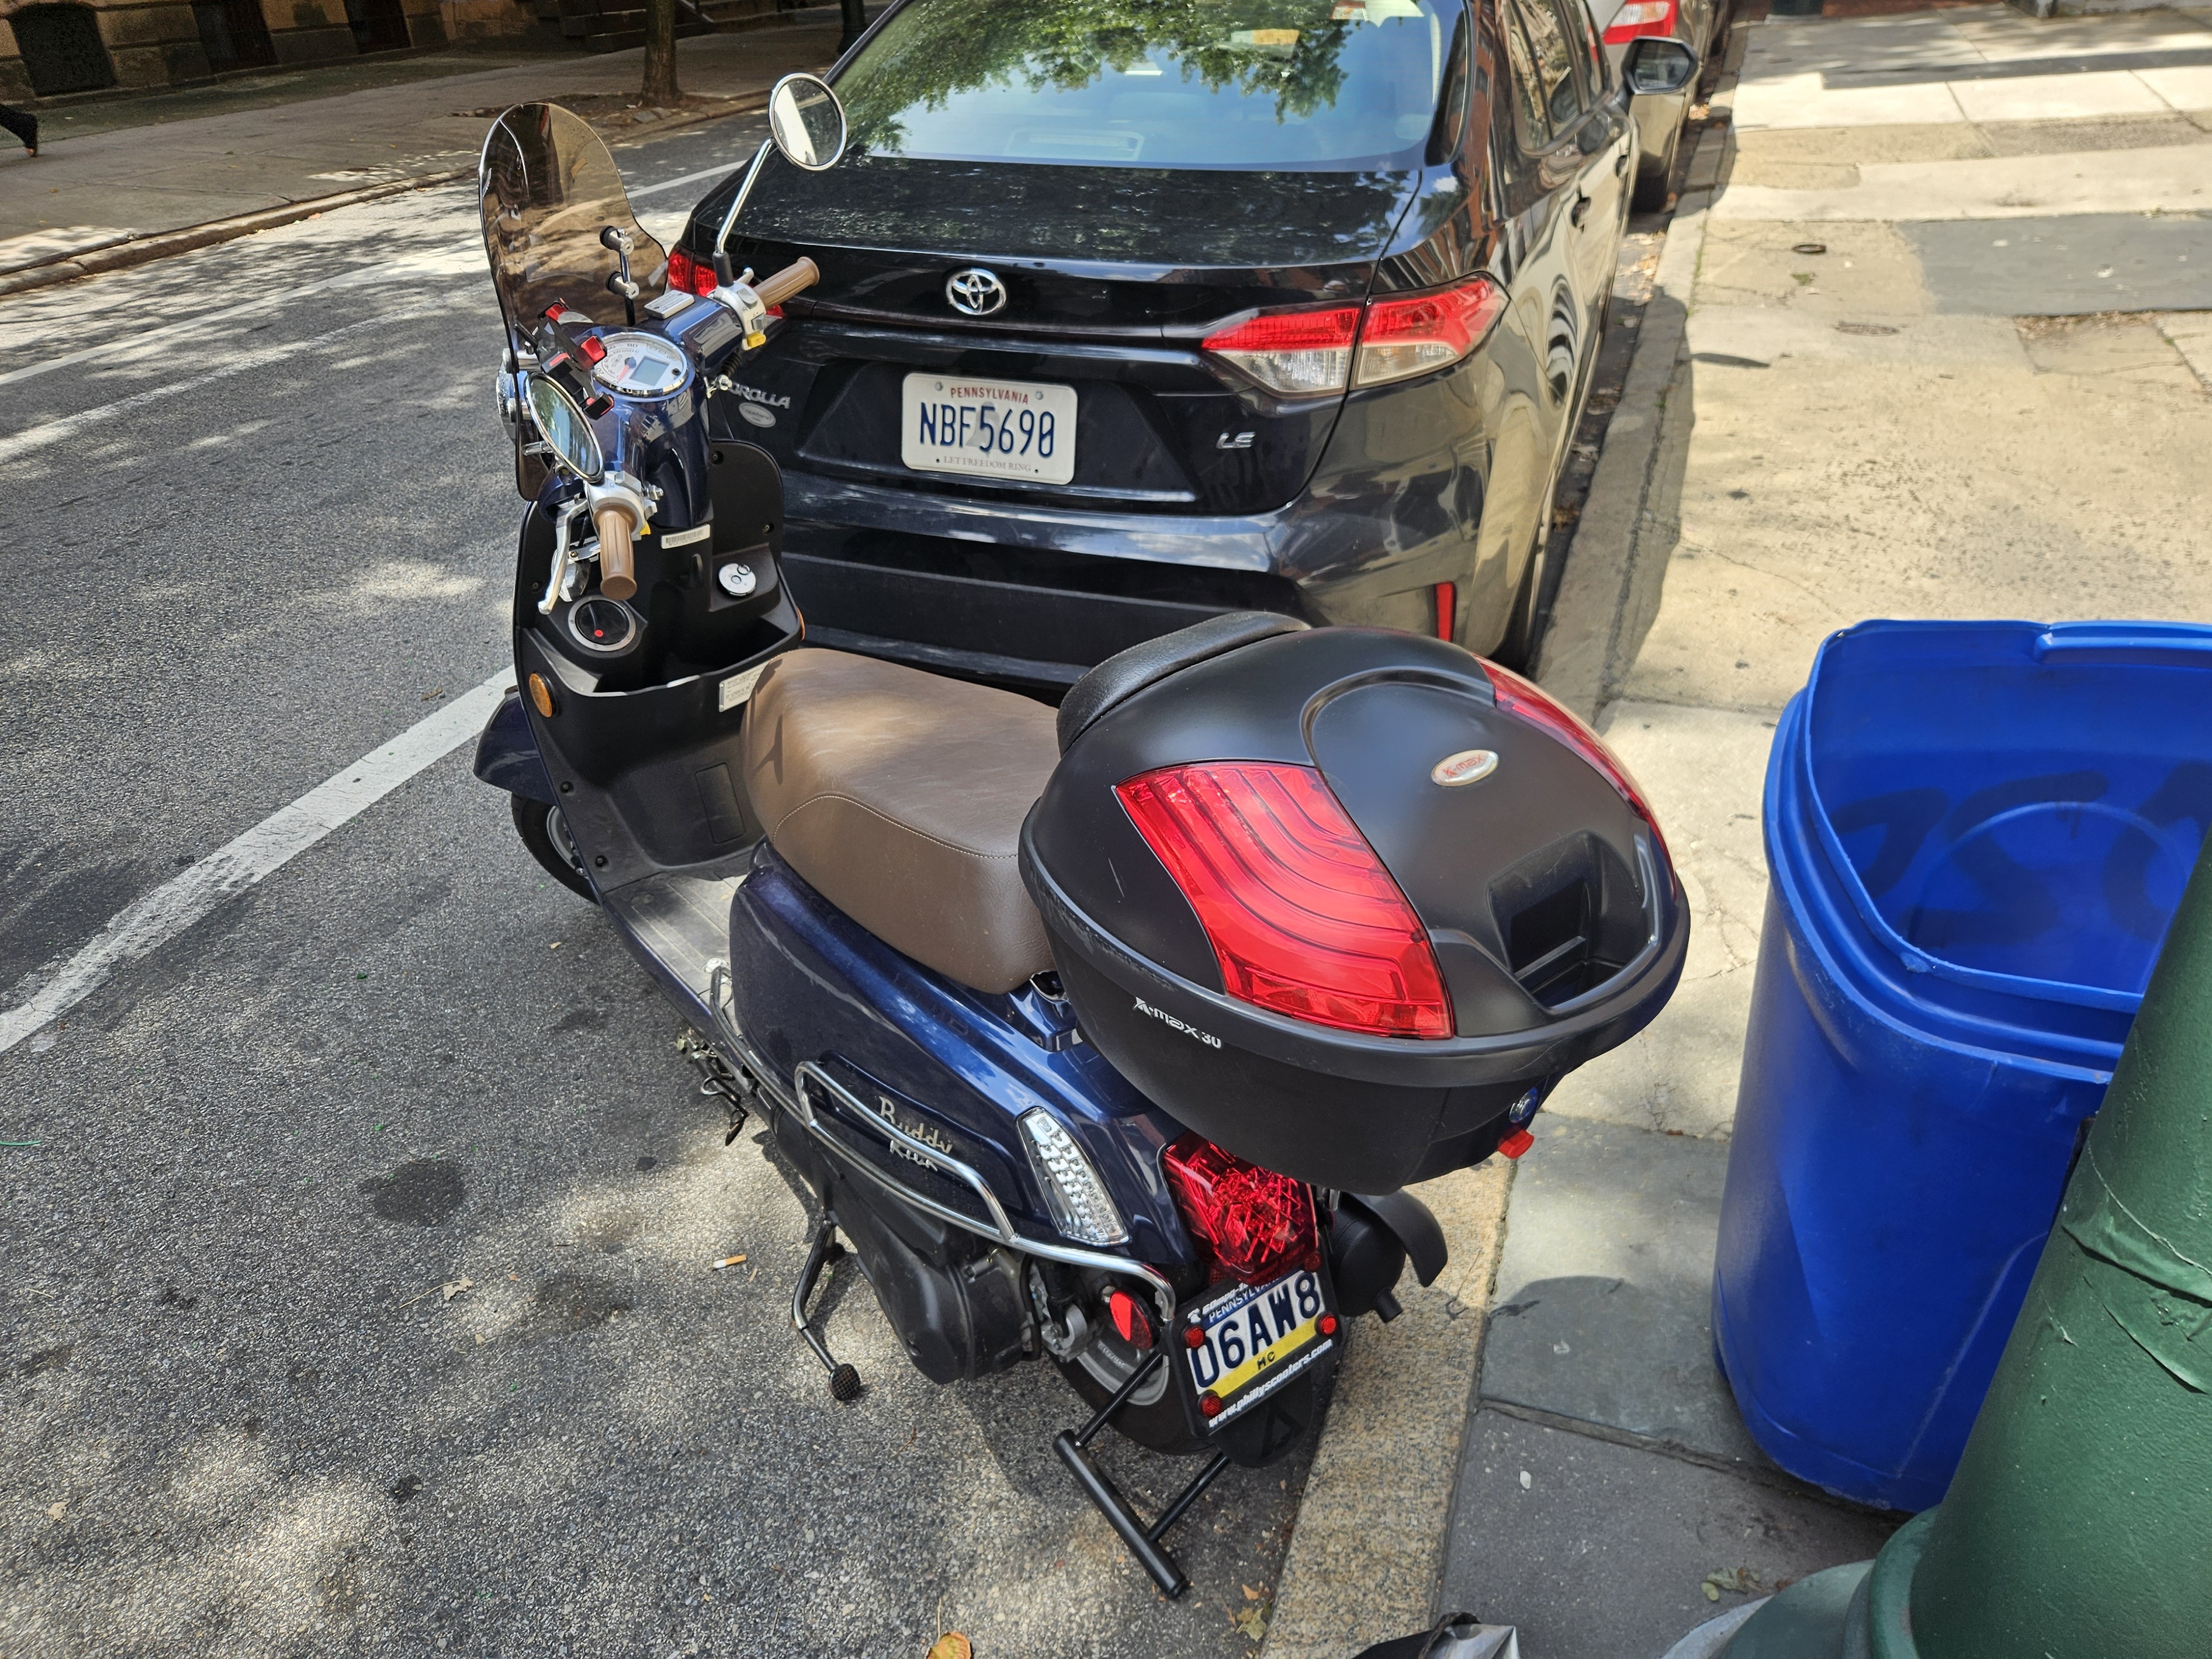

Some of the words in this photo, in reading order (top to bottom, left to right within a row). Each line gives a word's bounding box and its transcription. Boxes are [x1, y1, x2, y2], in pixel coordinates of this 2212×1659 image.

[728, 380, 791, 409] OROLLA
[951, 387, 1029, 405] PENNSYLVANIA
[920, 402, 1055, 458] NBF5690
[1217, 431, 1255, 449] LE
[943, 456, 961, 465] LET
[963, 457, 1006, 469] FREEDOM
[1009, 463, 1031, 472] RING
[1201, 1031, 1222, 1048] 30
[1191, 1272, 1320, 1387] 06AW8
[1256, 1351, 1275, 1370] MC
[1208, 1338, 1333, 1428] www.phillyscooters.com
